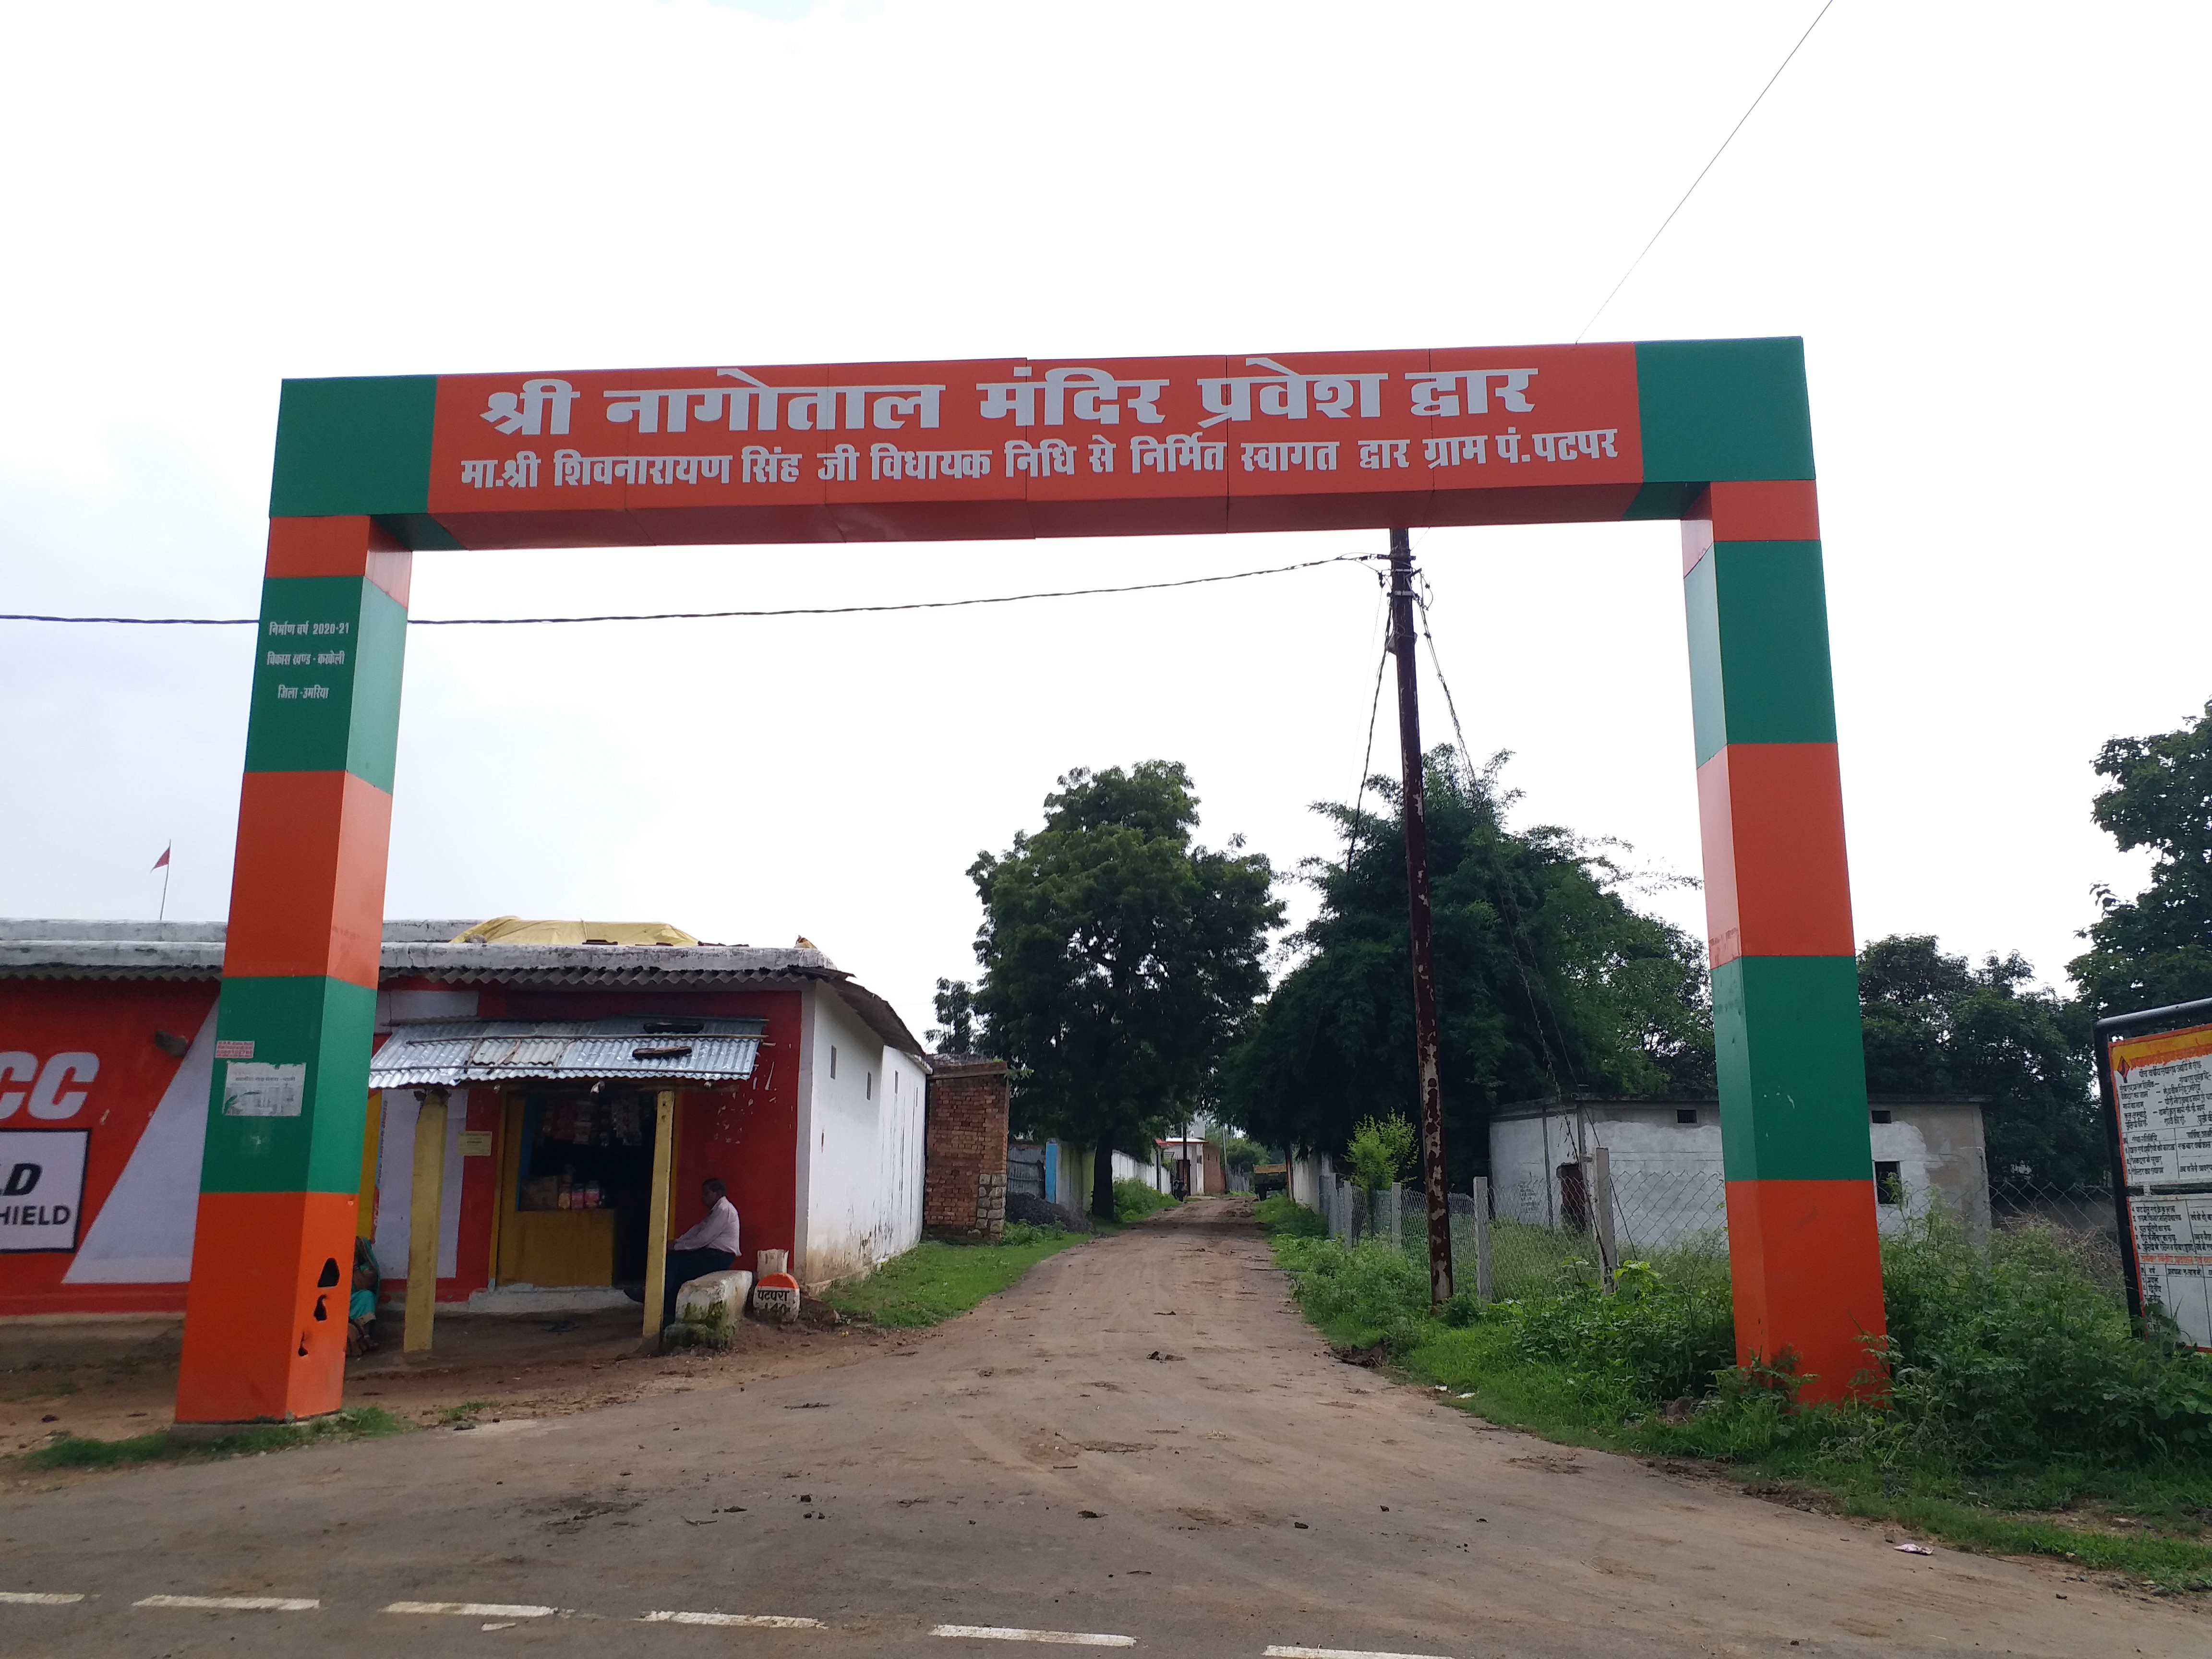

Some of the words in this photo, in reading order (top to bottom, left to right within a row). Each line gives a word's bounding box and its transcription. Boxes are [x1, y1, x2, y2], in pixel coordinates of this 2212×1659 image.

[480, 379, 580, 435] श्री
[603, 368, 946, 433] नागोताल
[975, 367, 1170, 427] मंदिर
[1197, 357, 1389, 429] प्रवेश
[1405, 368, 1538, 417] द्वार
[461, 451, 541, 489] मा.श्री
[553, 448, 733, 486] शिवनारायण
[741, 445, 802, 483] सिंह
[817, 444, 860, 481] जी
[870, 443, 993, 481] विधायक
[1004, 439, 1077, 478] निधि
[1088, 434, 1117, 472] से
[1130, 432, 1227, 473] निर्मित
[1240, 441, 1340, 471] स्वागत
[1358, 439, 1410, 469] द्वार
[1422, 435, 1488, 469] ग्राम
[269, 621, 295, 636] निर्माण
[297, 620, 310, 635] वर्ष
[313, 622, 349, 635] 2020-21
[277, 684, 299, 699] जिला
[757, 1289, 790, 1302] पटपरा
